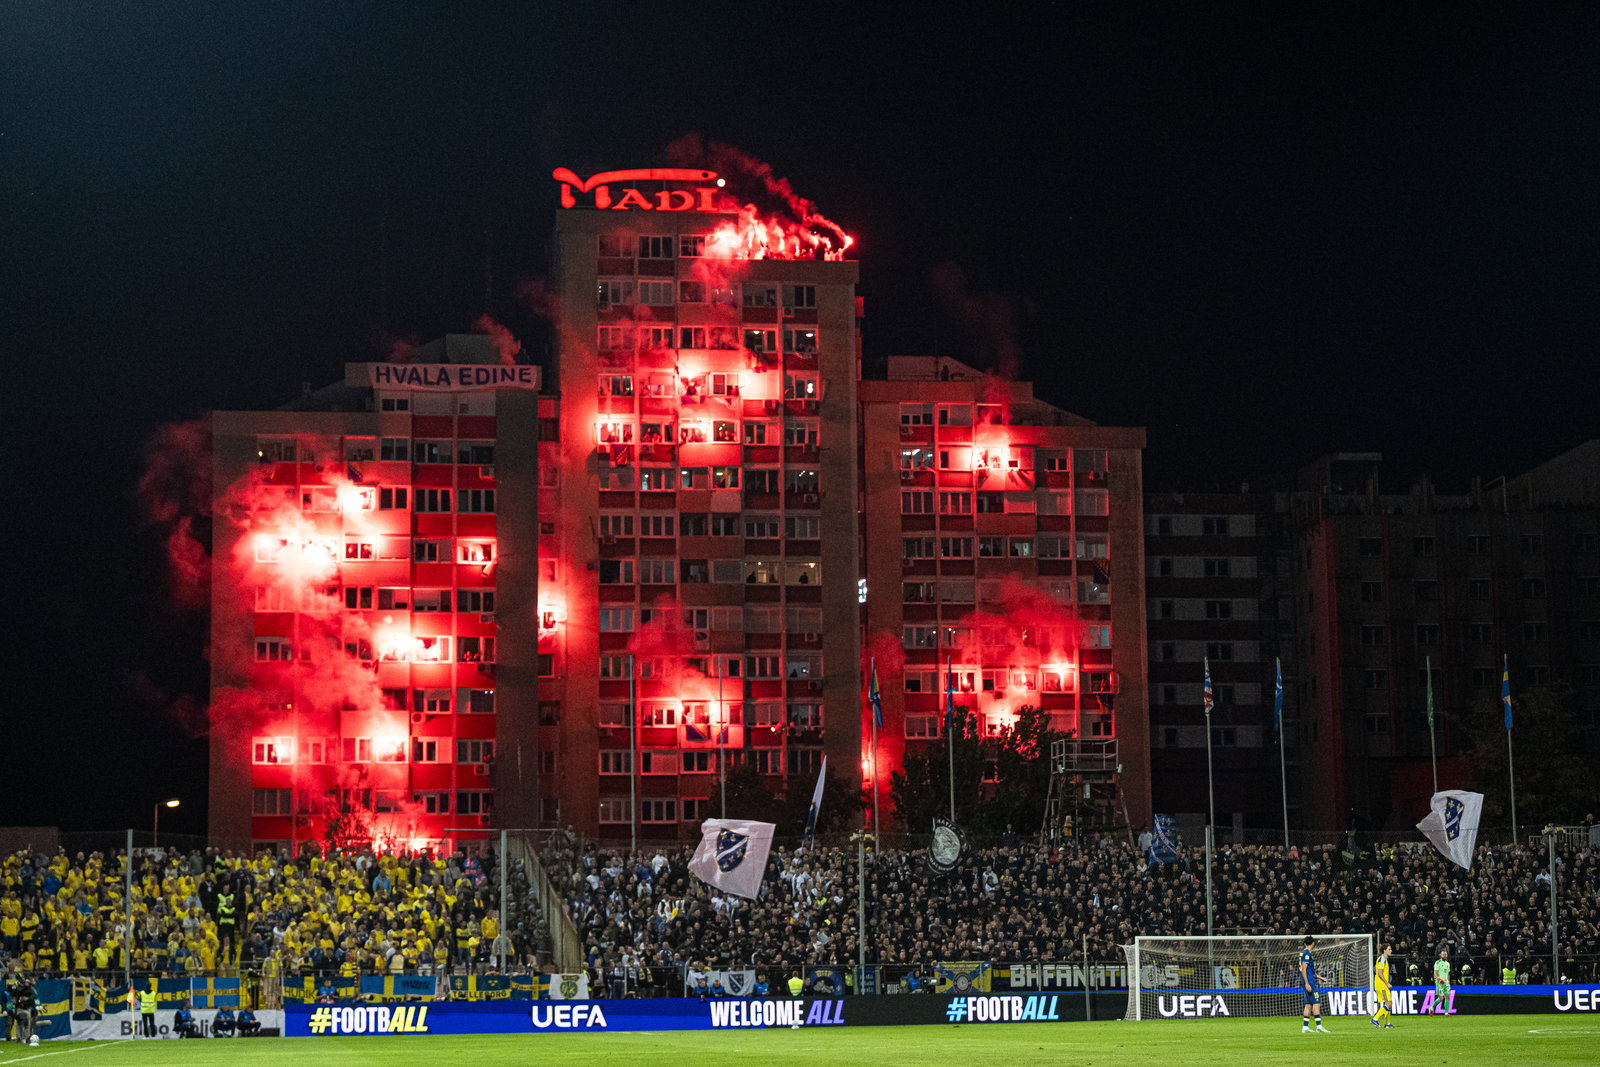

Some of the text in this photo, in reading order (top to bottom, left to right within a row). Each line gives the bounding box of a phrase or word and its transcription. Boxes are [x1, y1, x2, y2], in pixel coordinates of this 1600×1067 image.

[375, 366, 532, 386] HVALA EDINE
[710, 1000, 845, 1026] WELCOME ALL
[946, 995, 1059, 1022] #FOOTBALL
[1158, 995, 1230, 1017] UEFA
[1327, 990, 1418, 1015] WELCME
[308, 1006, 429, 1033] #FOOTBALL
[532, 1004, 607, 1028] UEFA
